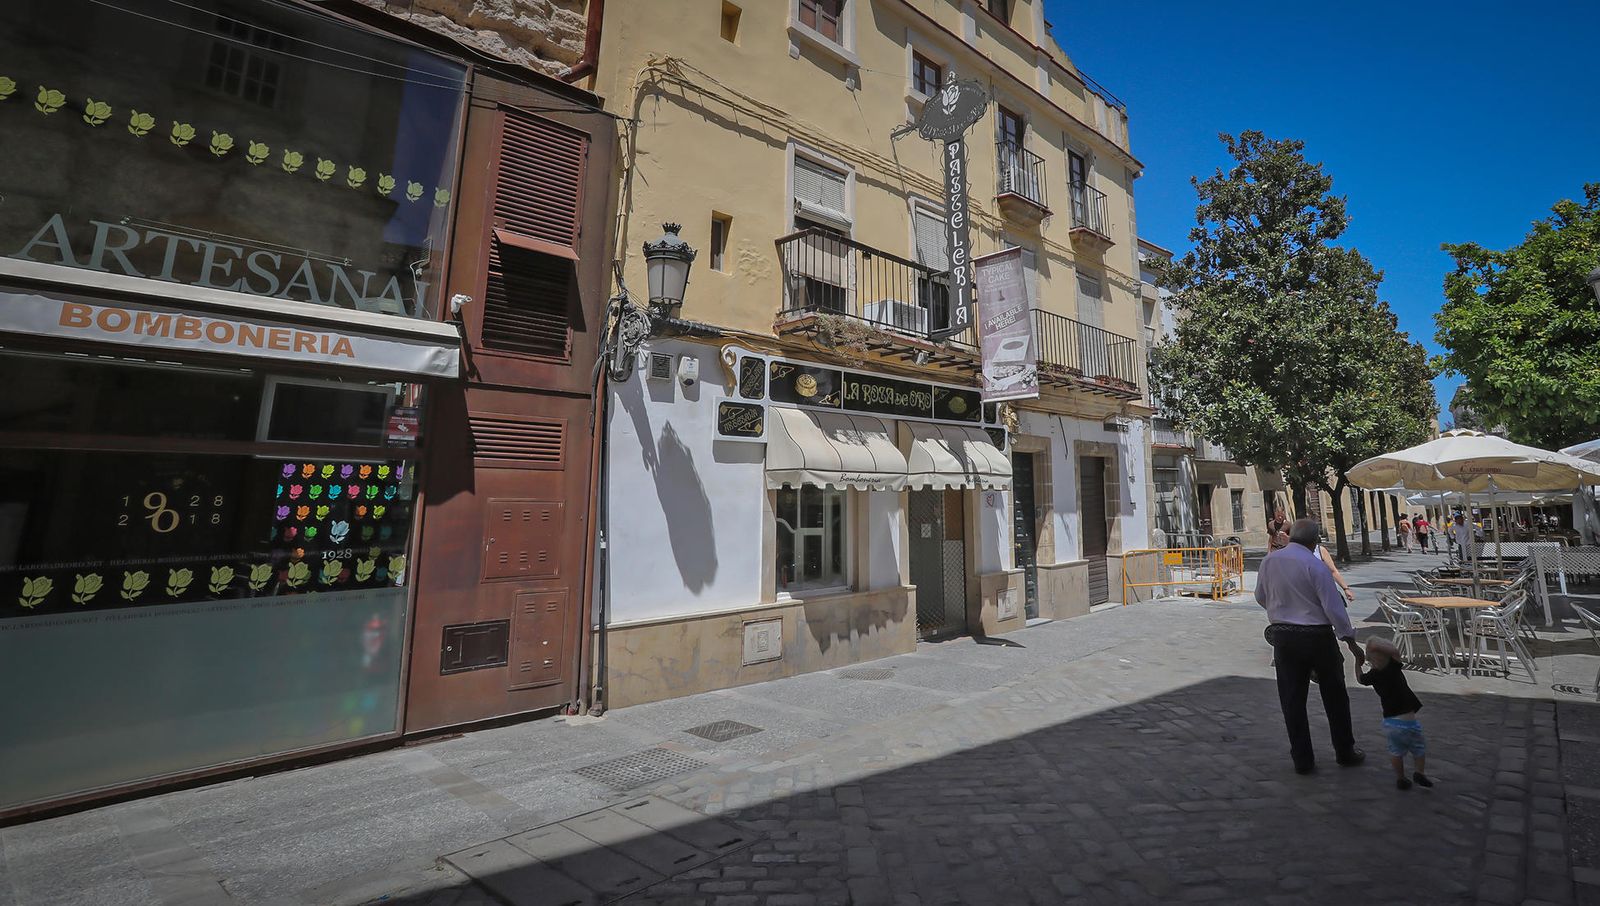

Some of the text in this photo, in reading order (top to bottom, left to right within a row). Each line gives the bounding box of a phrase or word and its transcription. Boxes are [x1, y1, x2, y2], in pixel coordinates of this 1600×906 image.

[988, 272, 1011, 284] CAKE
[58, 302, 355, 358] BOMBONERIA
[843, 381, 859, 401] LA
[321, 548, 353, 560] 1928
